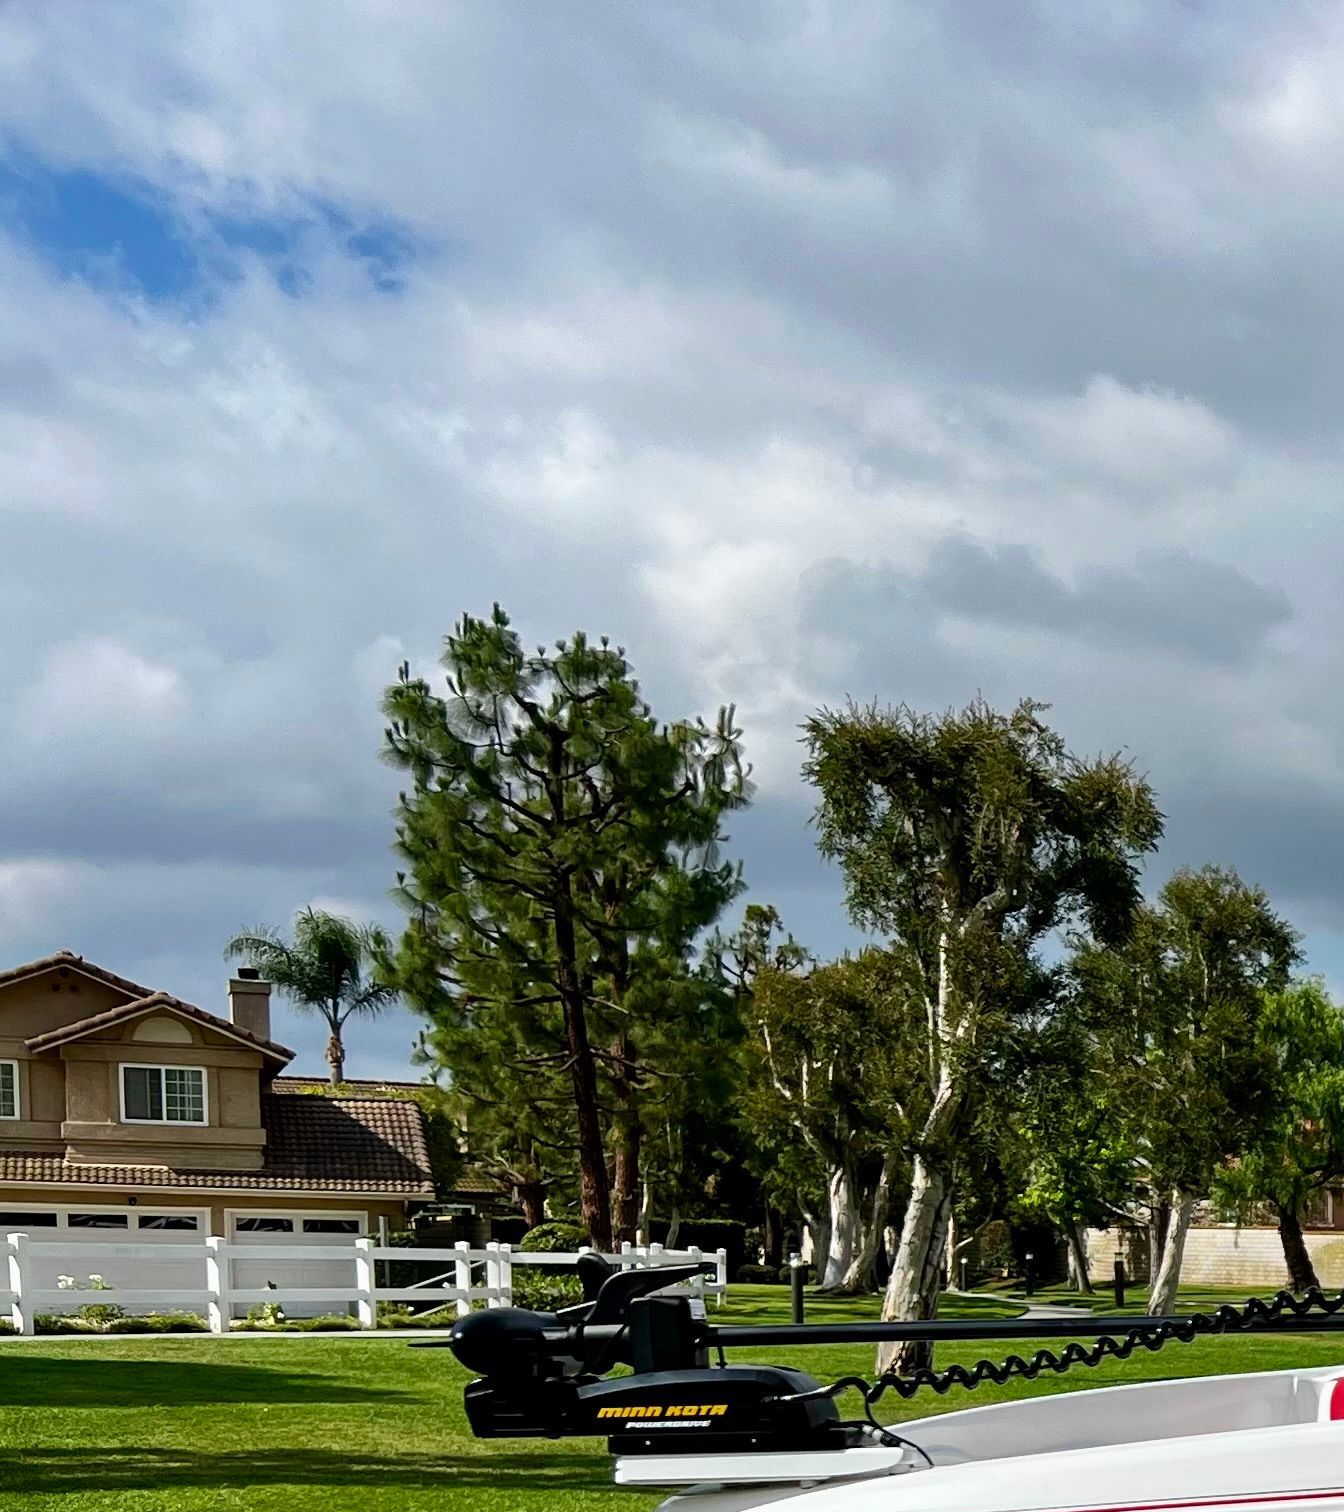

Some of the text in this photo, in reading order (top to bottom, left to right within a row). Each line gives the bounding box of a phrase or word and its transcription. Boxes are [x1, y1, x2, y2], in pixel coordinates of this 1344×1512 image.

[597, 1405, 728, 1418] MINN KOTA
[625, 1420, 711, 1429] POWERDRIVE
